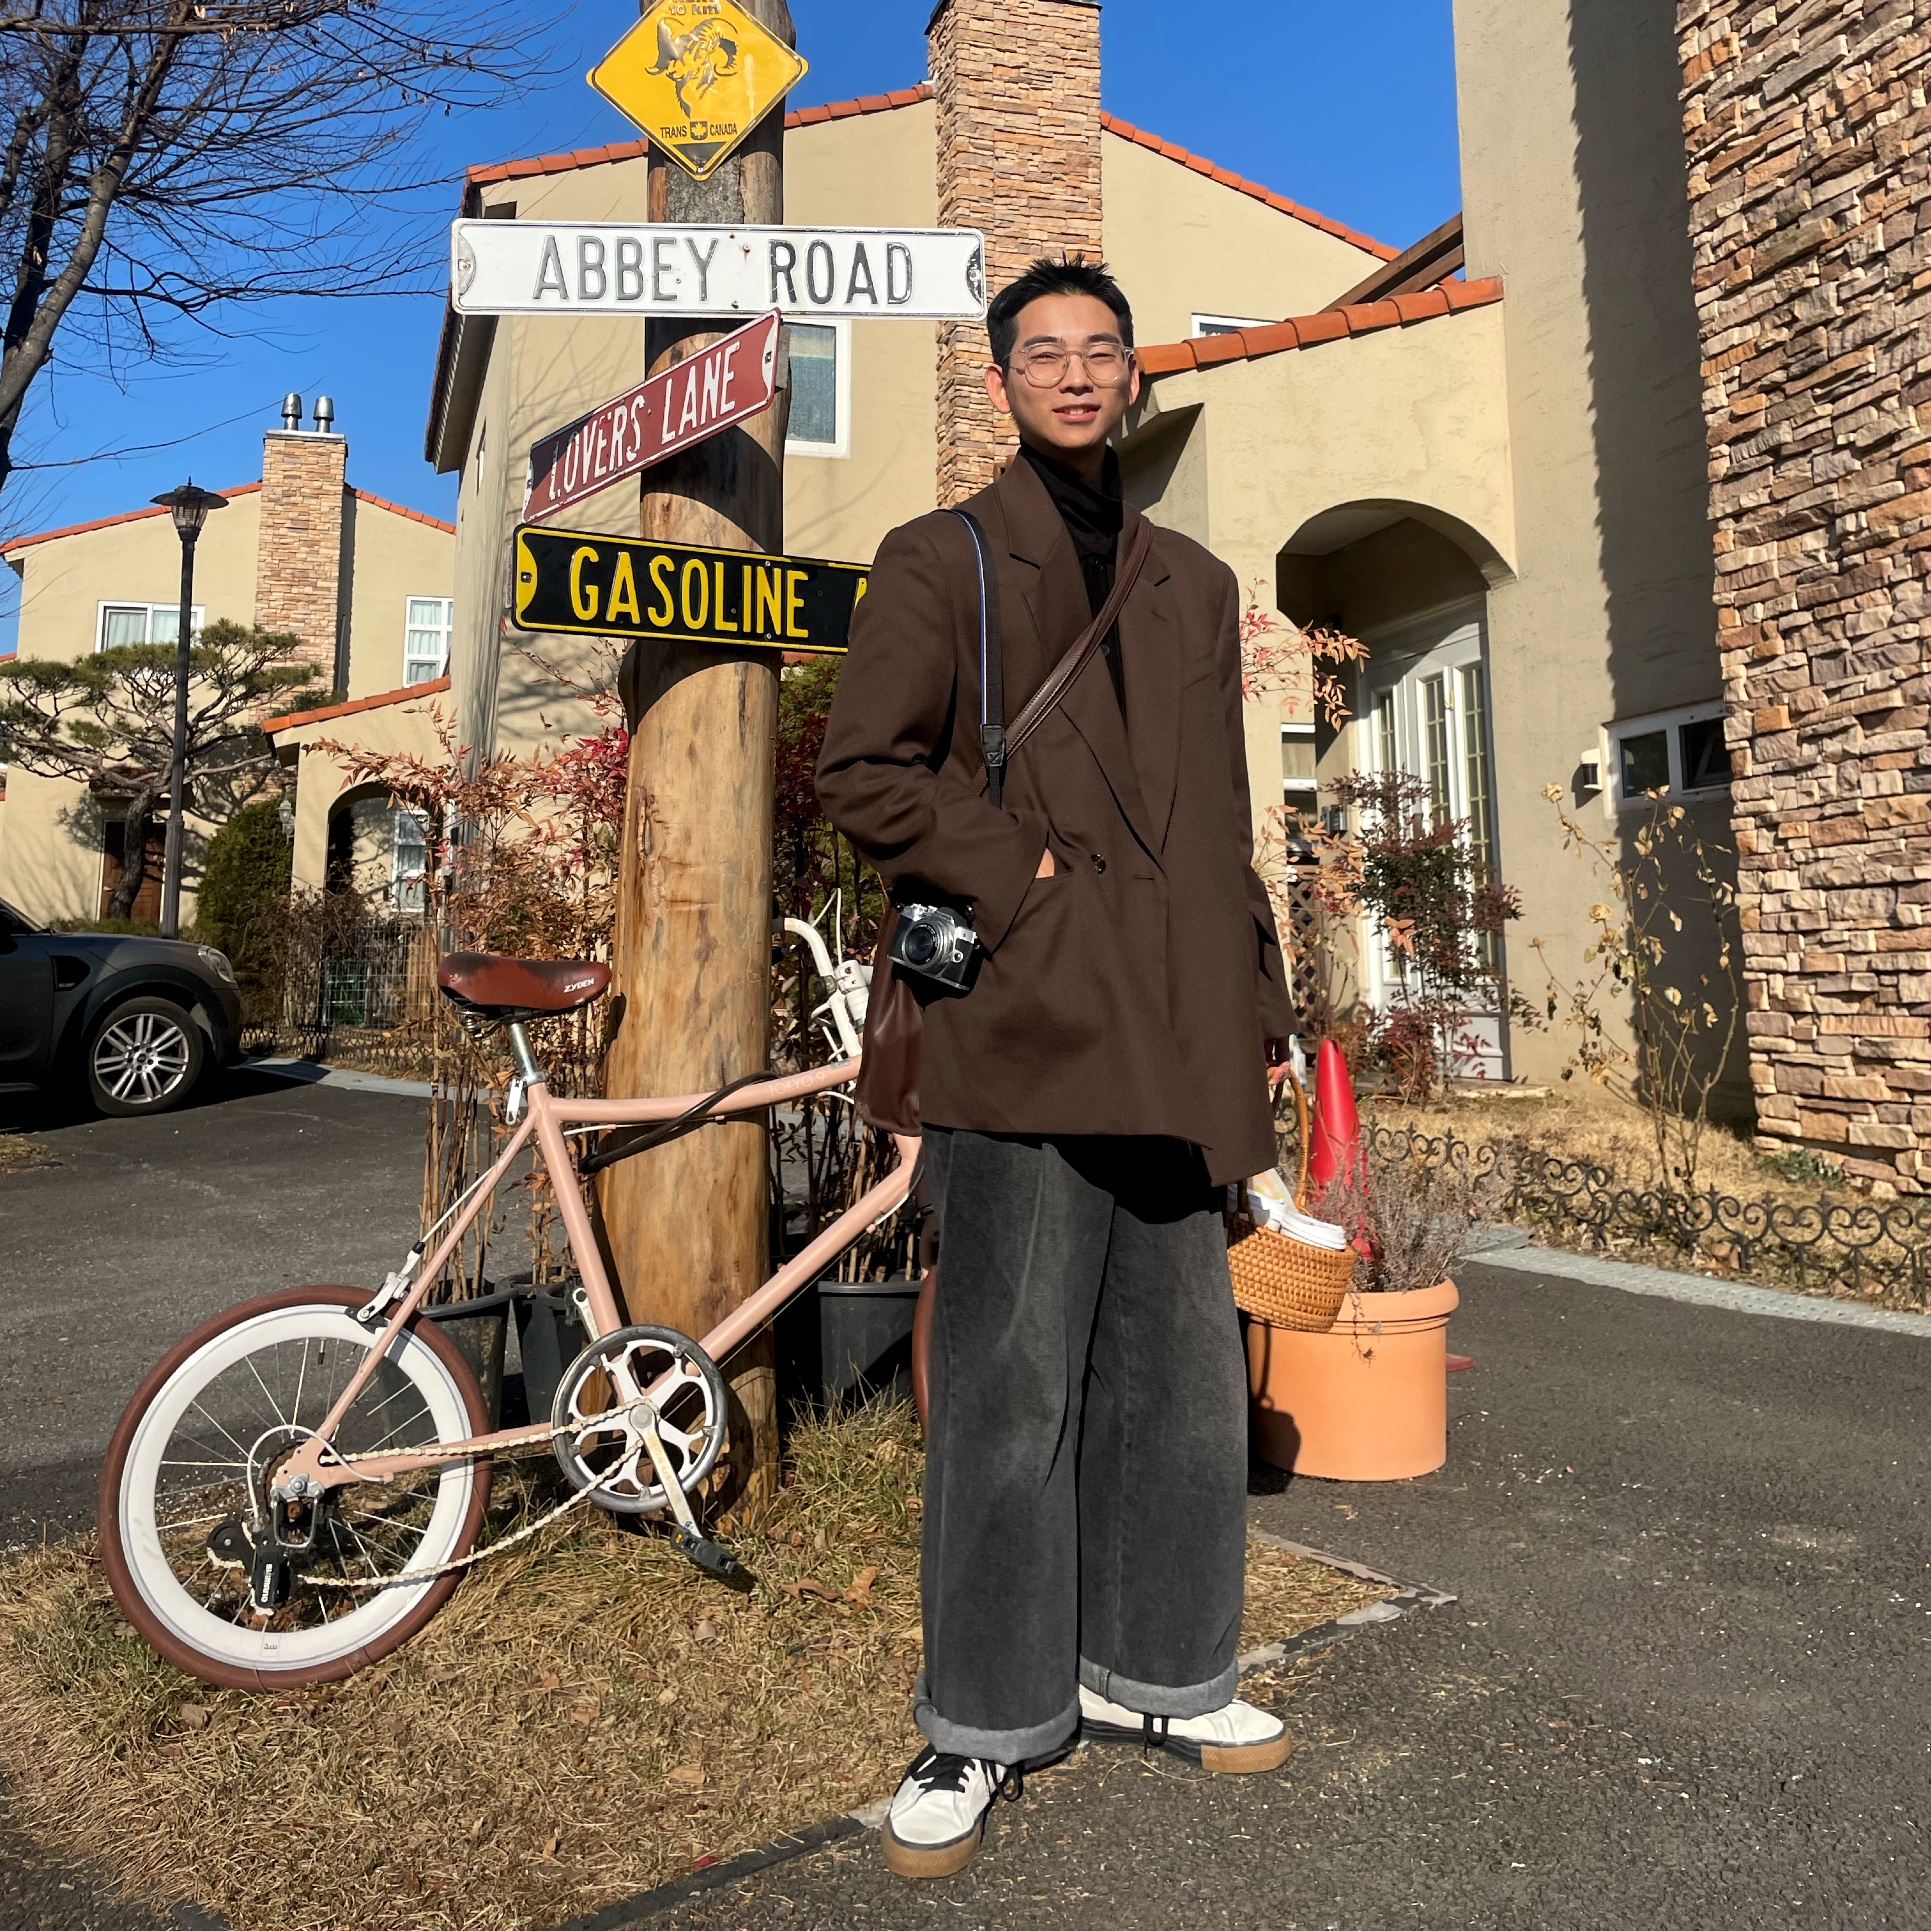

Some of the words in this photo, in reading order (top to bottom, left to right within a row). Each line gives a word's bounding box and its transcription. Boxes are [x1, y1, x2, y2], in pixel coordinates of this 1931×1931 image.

[692, 4, 721, 15] km
[660, 125, 688, 138] TRANS
[710, 123, 738, 136] CANADA
[532, 234, 719, 302] ABBEY
[768, 239, 914, 306] ROAD
[549, 394, 646, 500] LOVERS
[662, 341, 740, 445] LANE
[570, 546, 809, 639] GASOLINE
[563, 977, 595, 993] ZYDEN
[768, 1075, 813, 1097] TOKYO
[816, 1071, 825, 1083] 9
